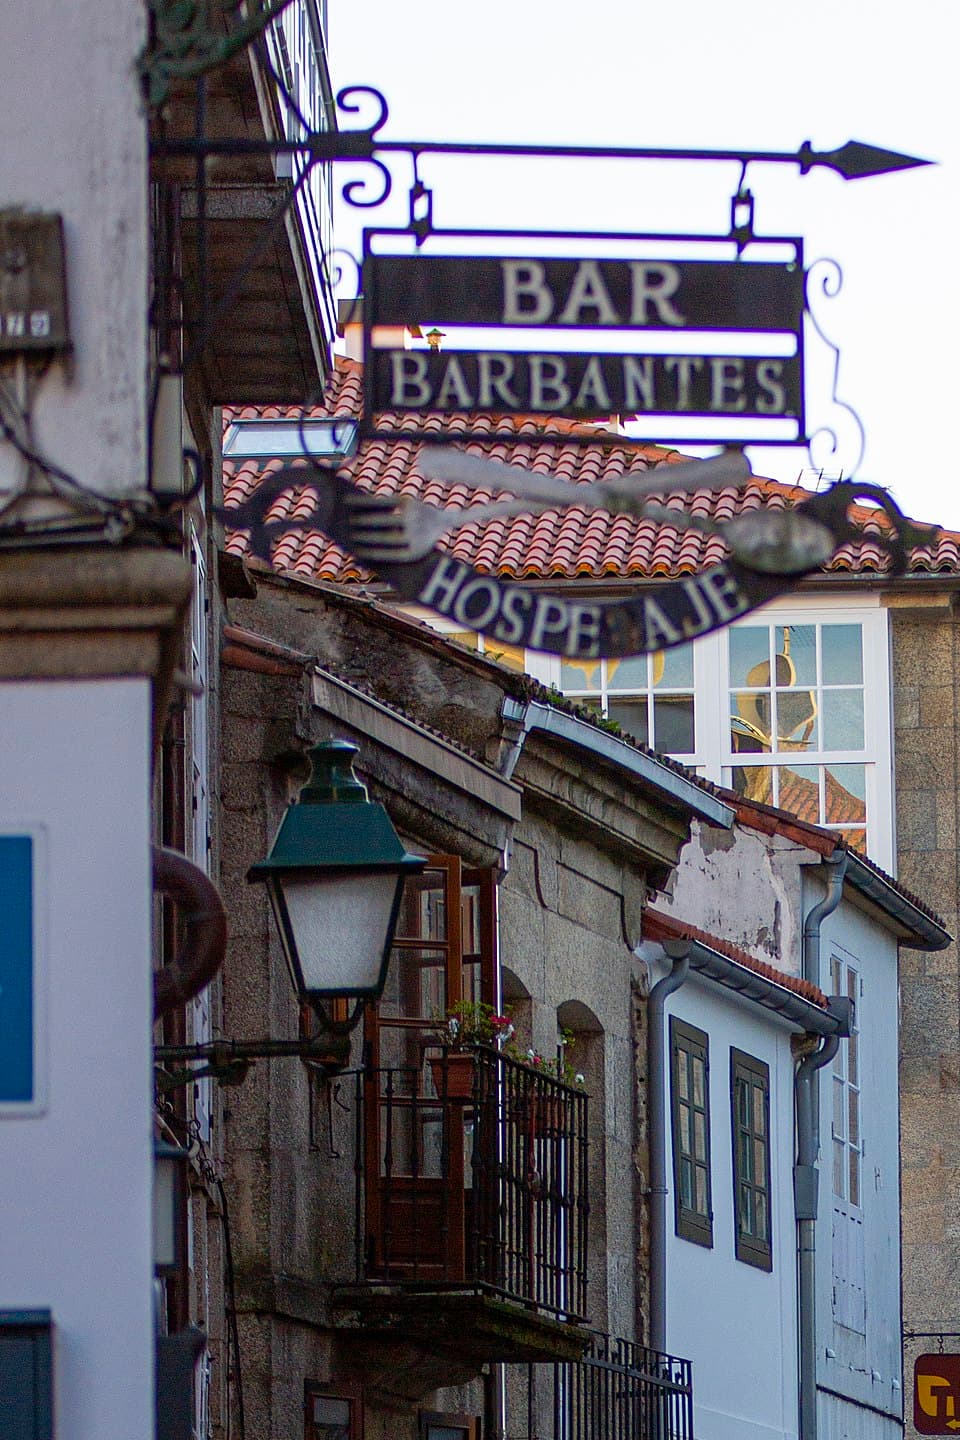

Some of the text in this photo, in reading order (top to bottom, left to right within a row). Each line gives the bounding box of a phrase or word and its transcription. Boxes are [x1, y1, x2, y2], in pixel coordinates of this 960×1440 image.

[502, 260, 686, 326] BAR
[390, 351, 786, 412] BARBANTES
[421, 558, 748, 657] HOSPEAJE
